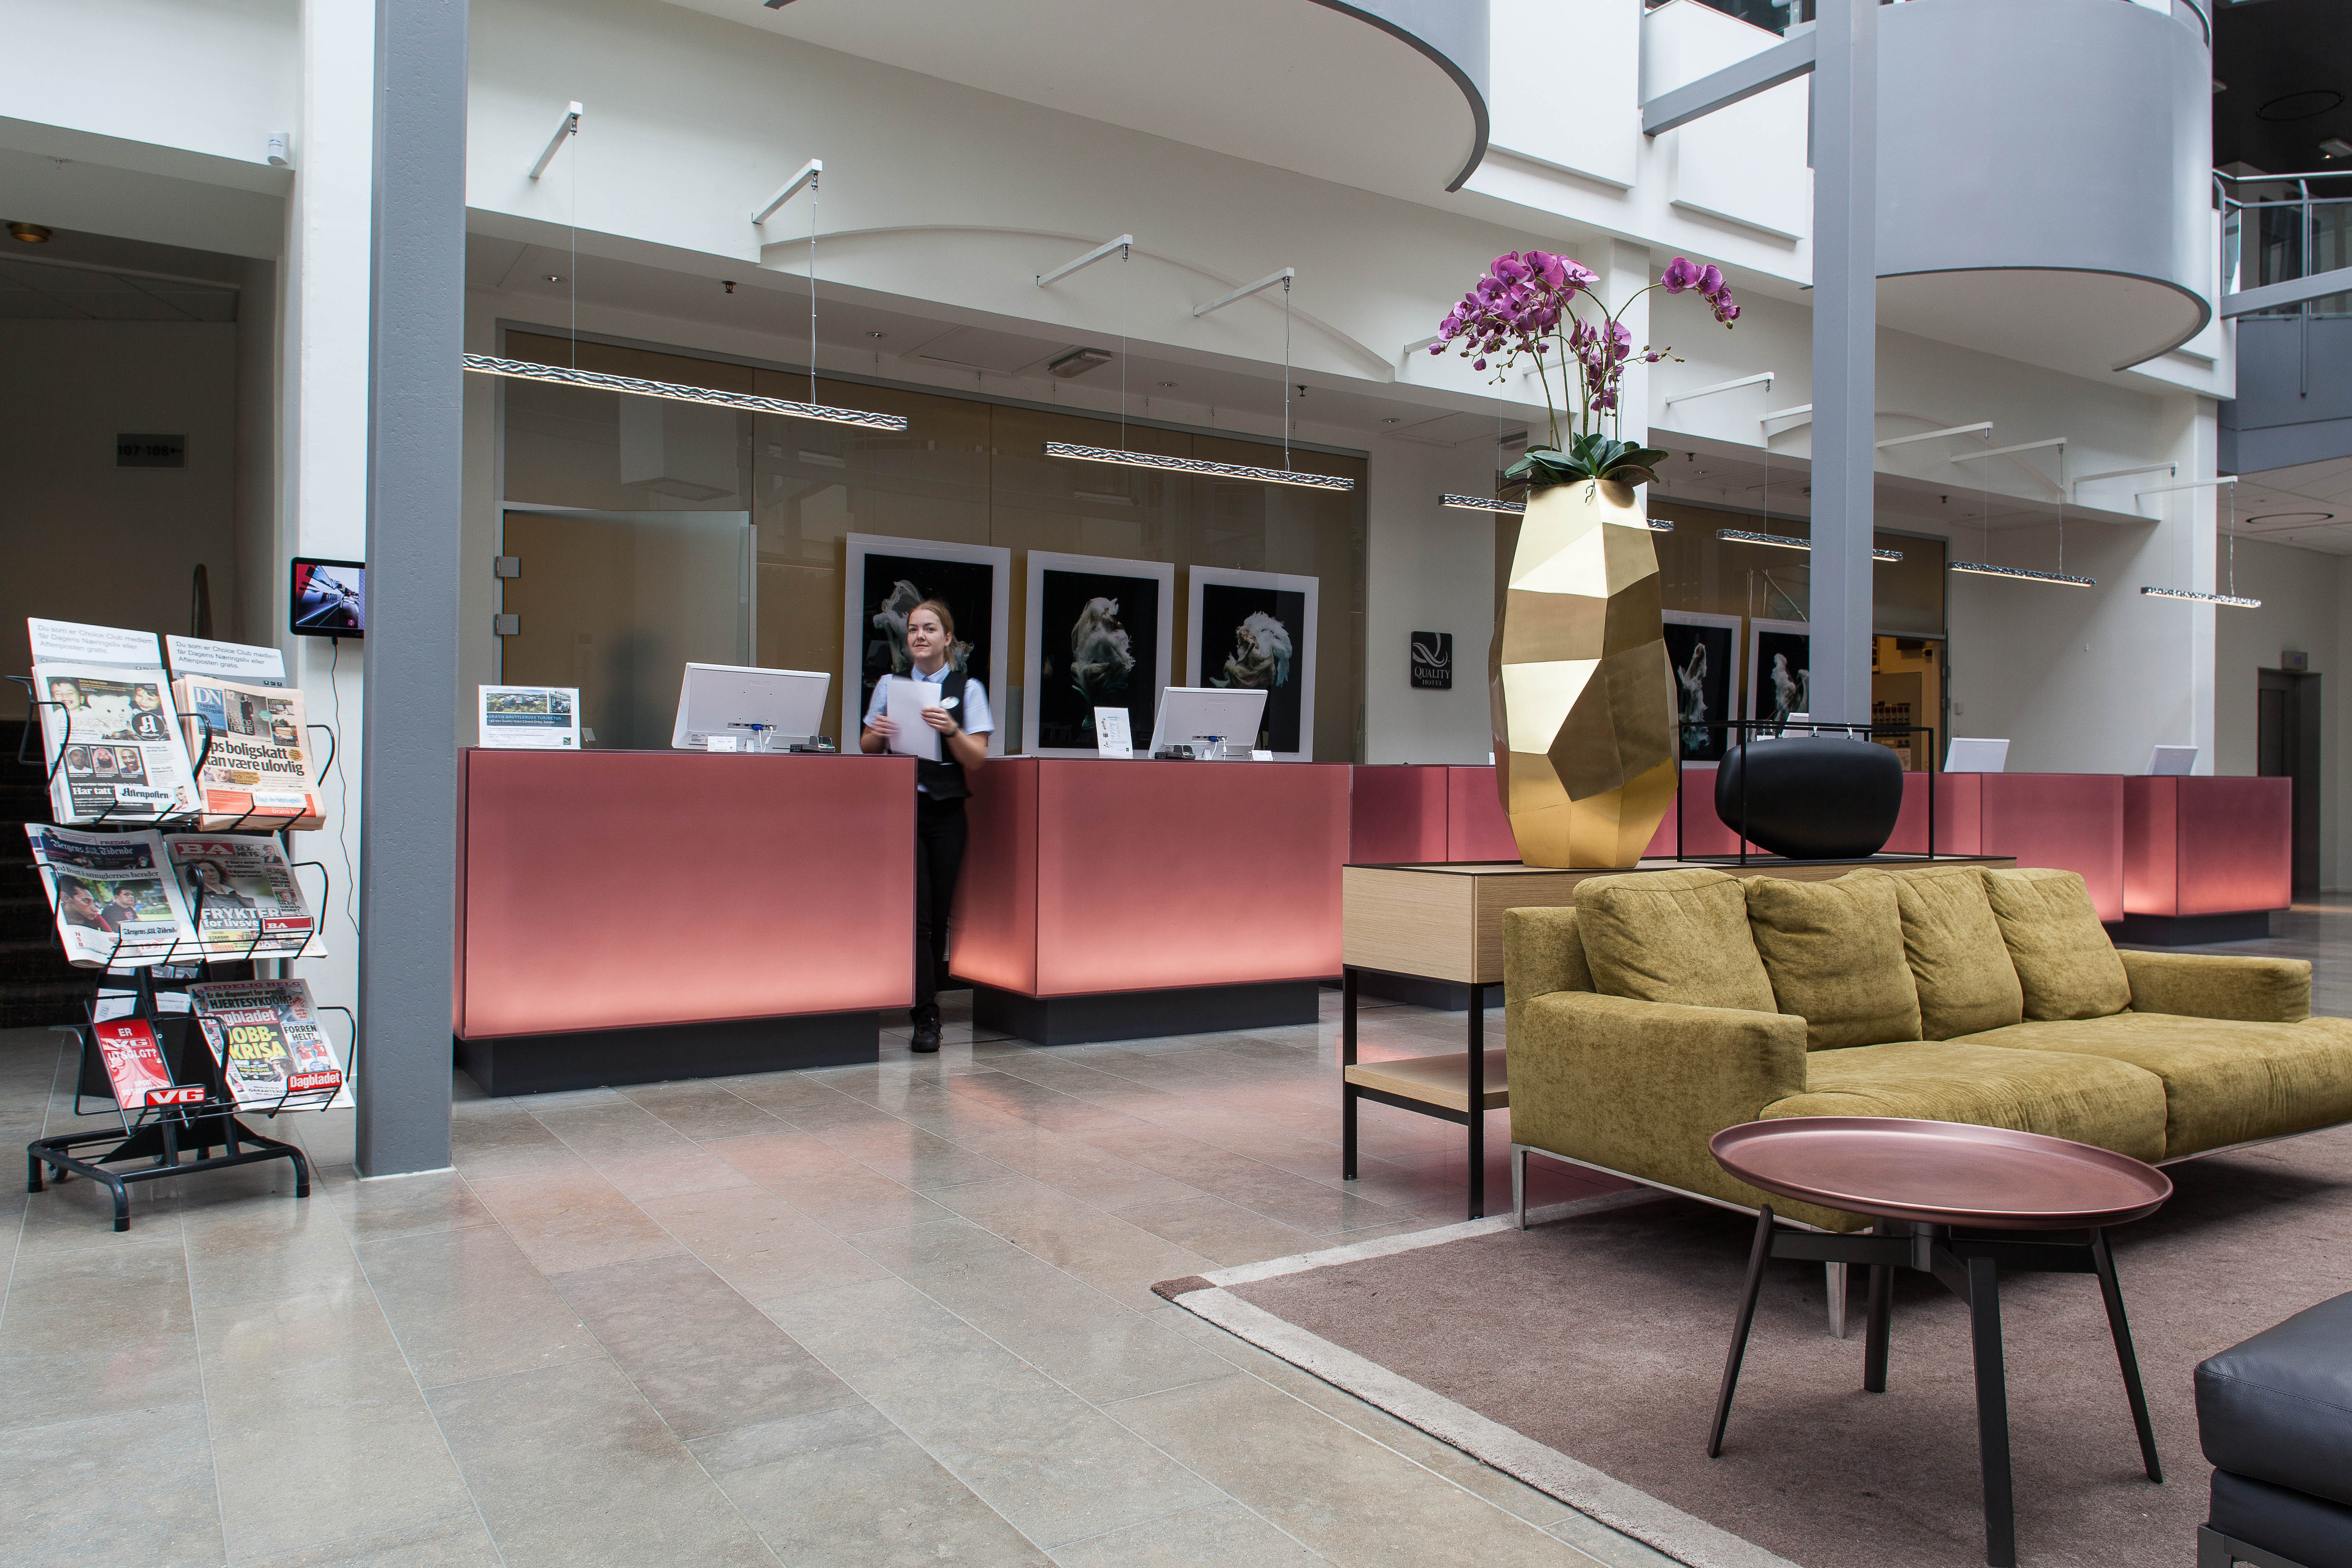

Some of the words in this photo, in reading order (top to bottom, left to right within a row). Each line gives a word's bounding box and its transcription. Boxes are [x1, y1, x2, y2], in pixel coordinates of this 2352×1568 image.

[79, 630, 104, 638] Choice
[41, 641, 85, 651] Aftenposten
[52, 634, 80, 644] Dagens
[82, 638, 121, 648] Næringsliv
[213, 646, 235, 654] Choice
[178, 656, 219, 666] Aftenposten
[188, 650, 214, 659] Dagens
[216, 654, 250, 664] Næringsliv
[1414, 666, 1450, 679] QUALITY
[194, 687, 222, 705] DN
[225, 740, 289, 759] boligskatt
[228, 758, 260, 771] være
[261, 759, 305, 776] ulovlig
[72, 787, 93, 795] Har
[94, 787, 113, 795] tatt
[50, 839, 84, 854] Bergens
[100, 846, 134, 855] Tidende
[178, 843, 233, 855] BA
[201, 908, 283, 919] FRYKTER
[203, 919, 225, 928] for
[203, 983, 262, 991] ENDELIG
[209, 995, 293, 1009] HJERTESYKDOM?
[118, 1027, 133, 1037] ER
[229, 1026, 278, 1043] JOBB-
[283, 1025, 317, 1034] FORREN
[292, 1033, 315, 1041] HELT!
[107, 1048, 157, 1062] UTSOLGT?
[229, 1041, 288, 1060] KRISA
[289, 1074, 340, 1089] Dagbladet
[149, 1089, 204, 1104] VG
